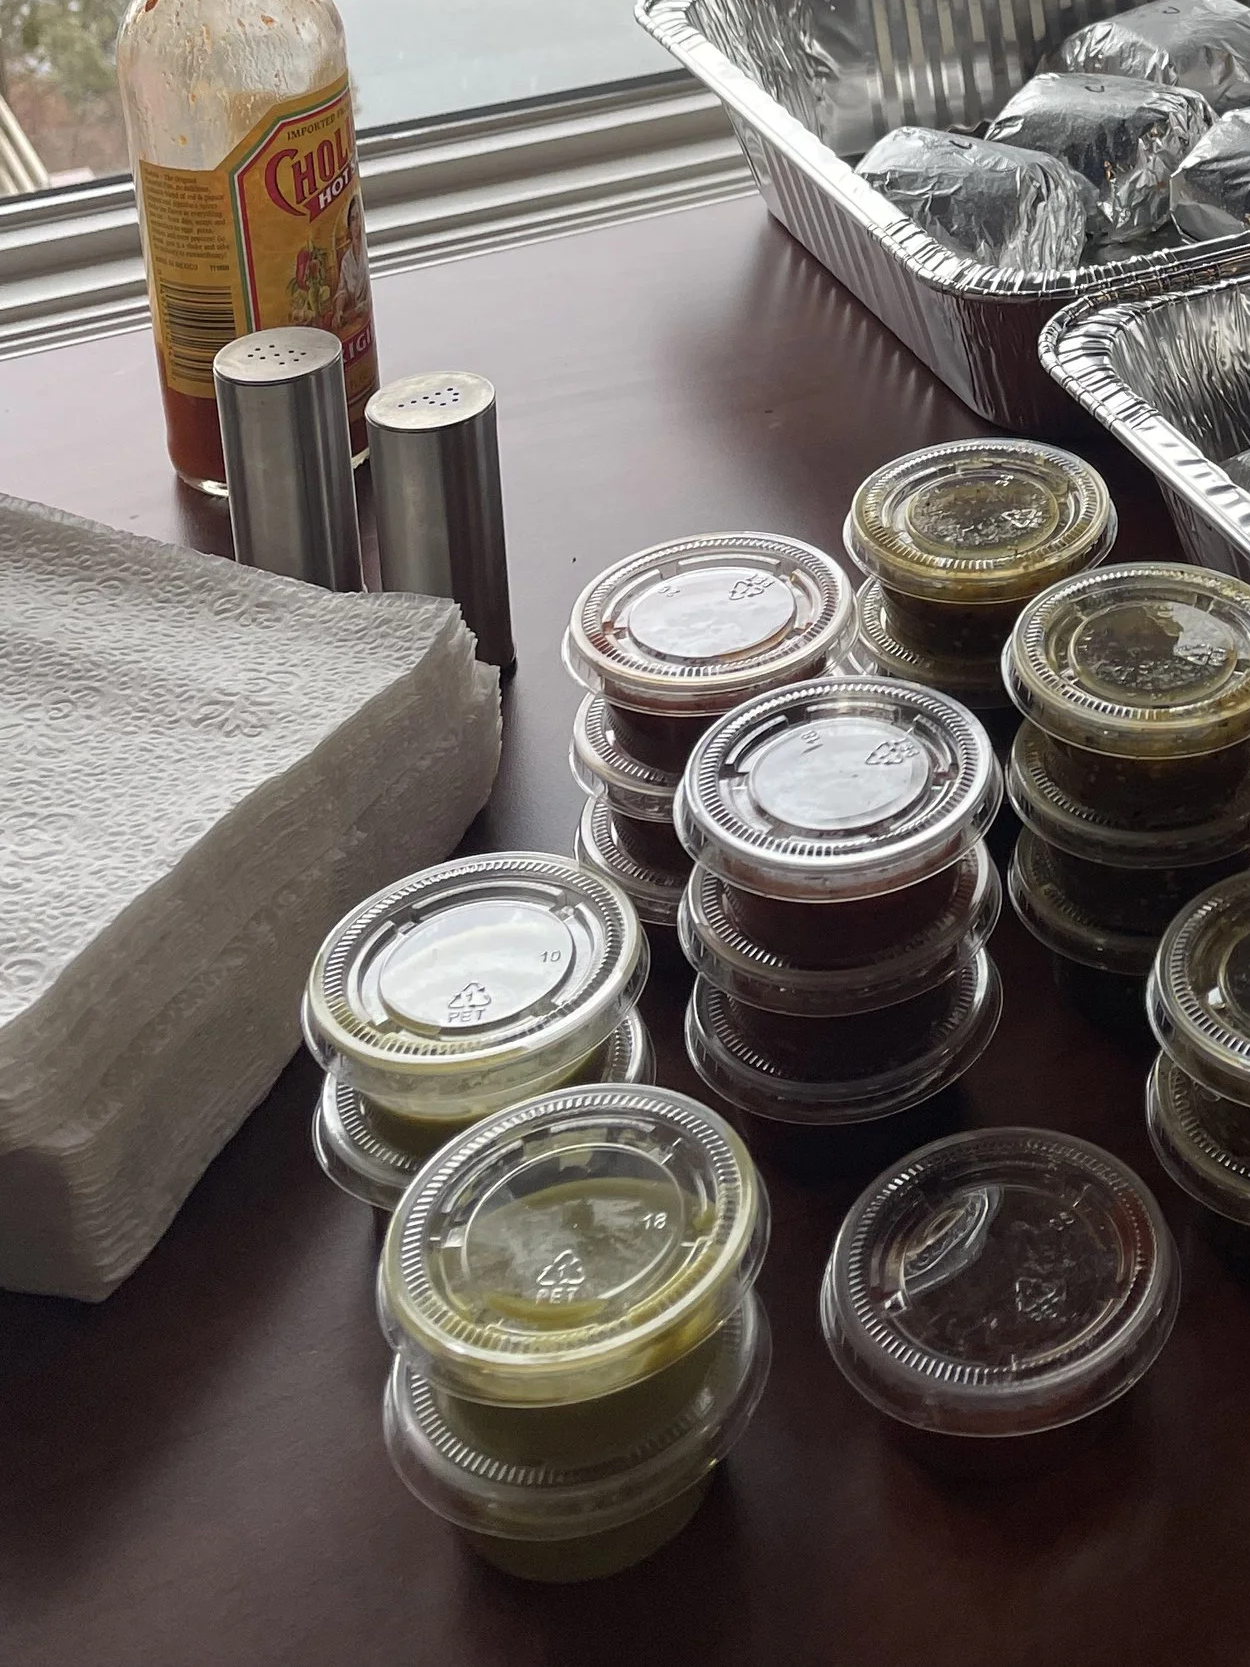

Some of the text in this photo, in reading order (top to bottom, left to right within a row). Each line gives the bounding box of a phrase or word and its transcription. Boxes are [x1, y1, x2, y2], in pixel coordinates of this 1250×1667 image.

[287, 113, 335, 141] IMPORTED
[318, 169, 350, 209] HOT
[538, 949, 562, 963] 10
[448, 1008, 487, 1023] PET
[641, 1212, 668, 1230] 18
[536, 1286, 579, 1305] PET
